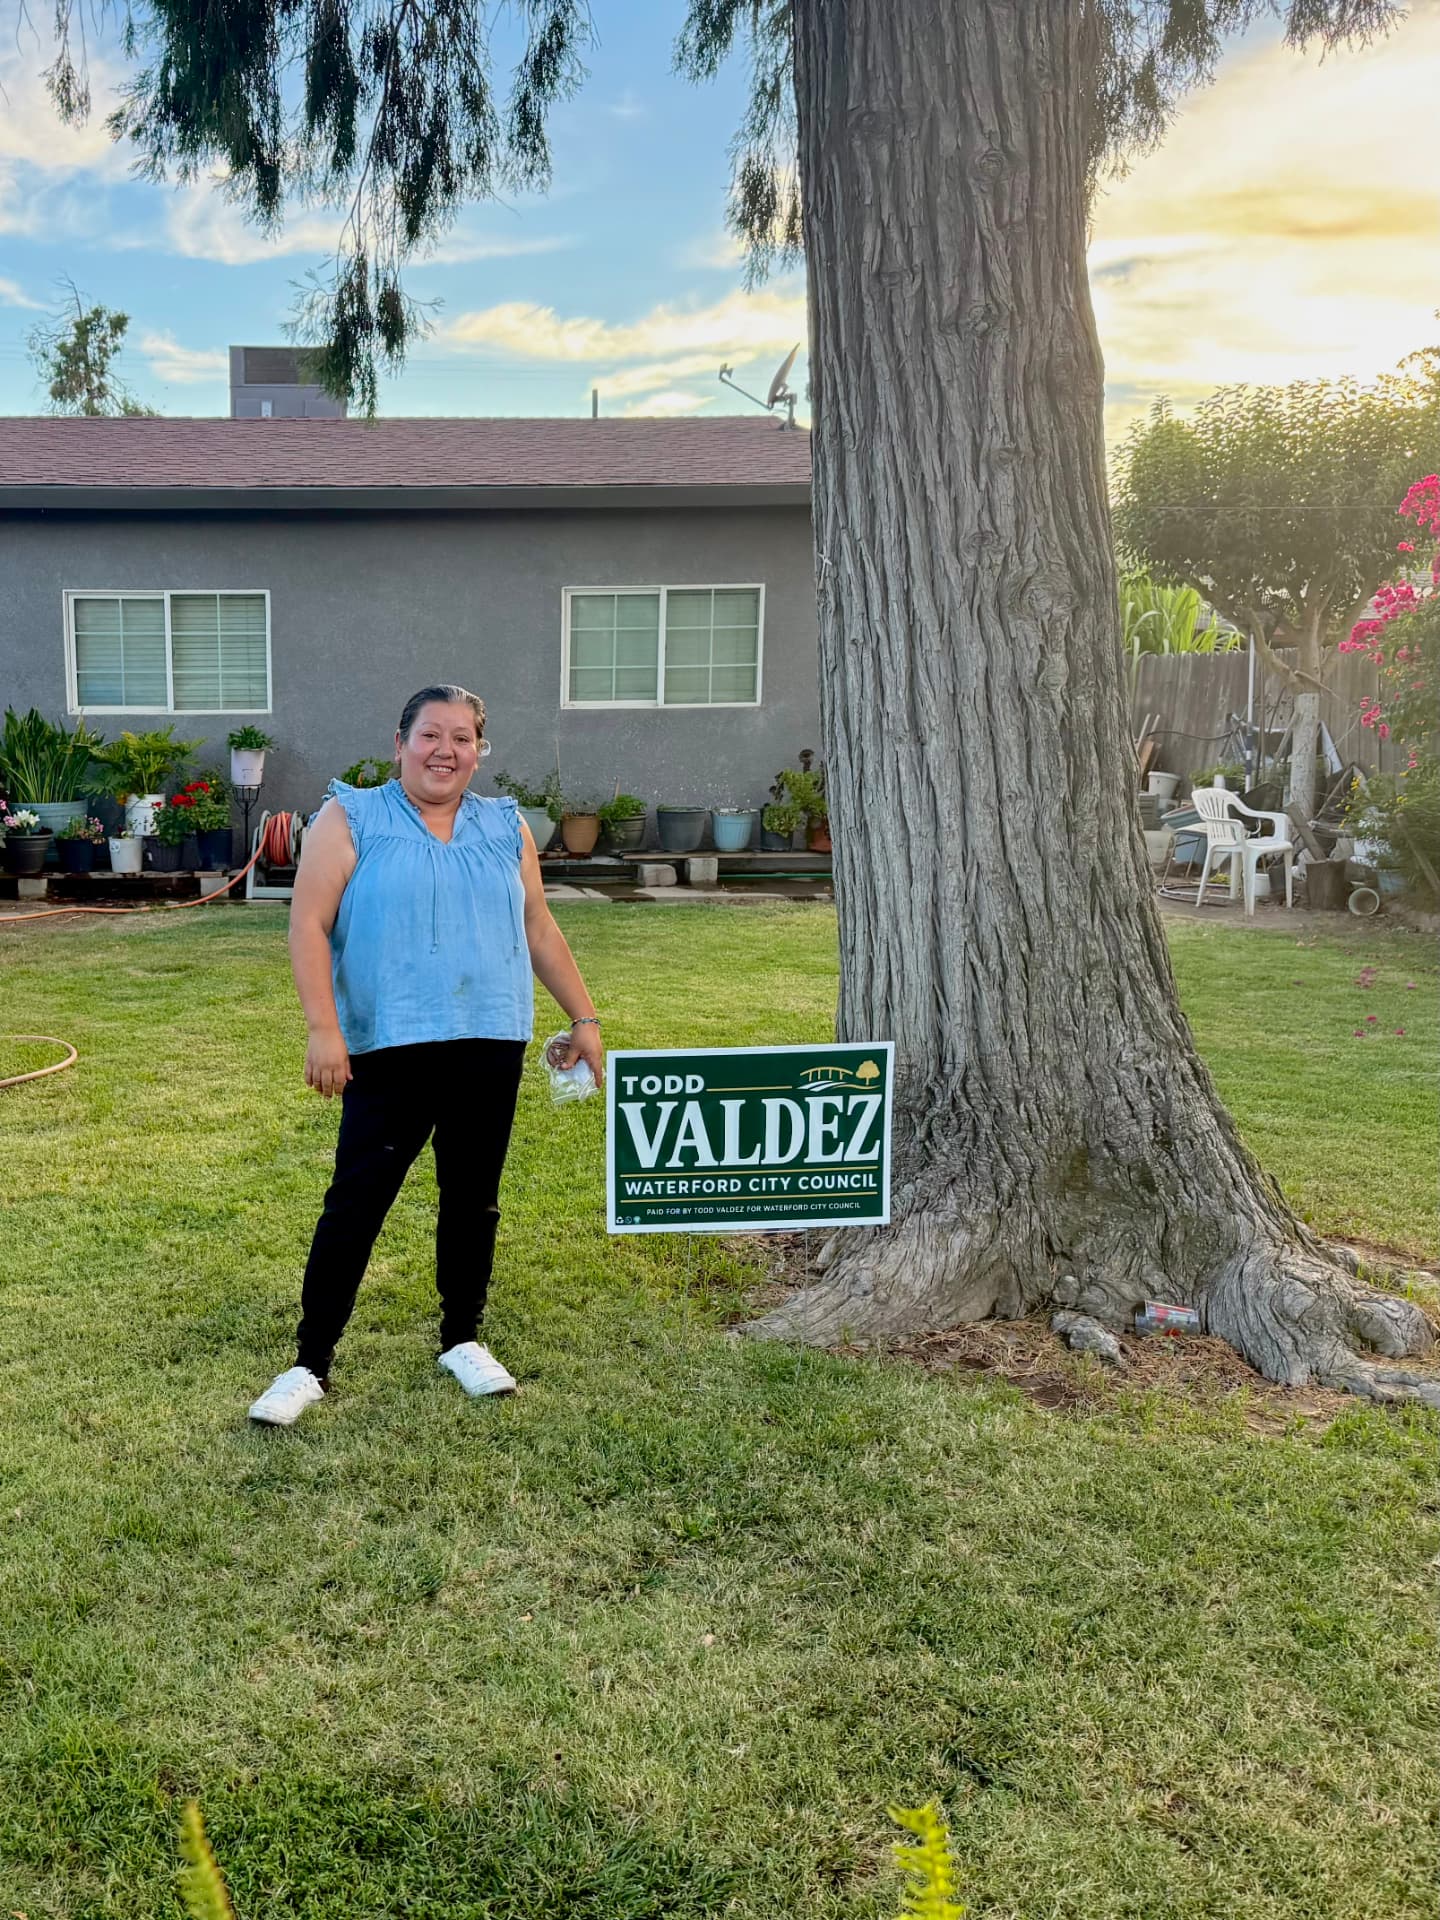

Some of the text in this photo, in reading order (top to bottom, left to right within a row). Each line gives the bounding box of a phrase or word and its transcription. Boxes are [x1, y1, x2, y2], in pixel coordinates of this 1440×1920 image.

[622, 1075, 704, 1095] TODD
[618, 1094, 883, 1169] VALDEZ
[625, 1174, 877, 1195] WATERFORD CITY COUNCIL
[763, 1204, 808, 1212] WATERFORD
